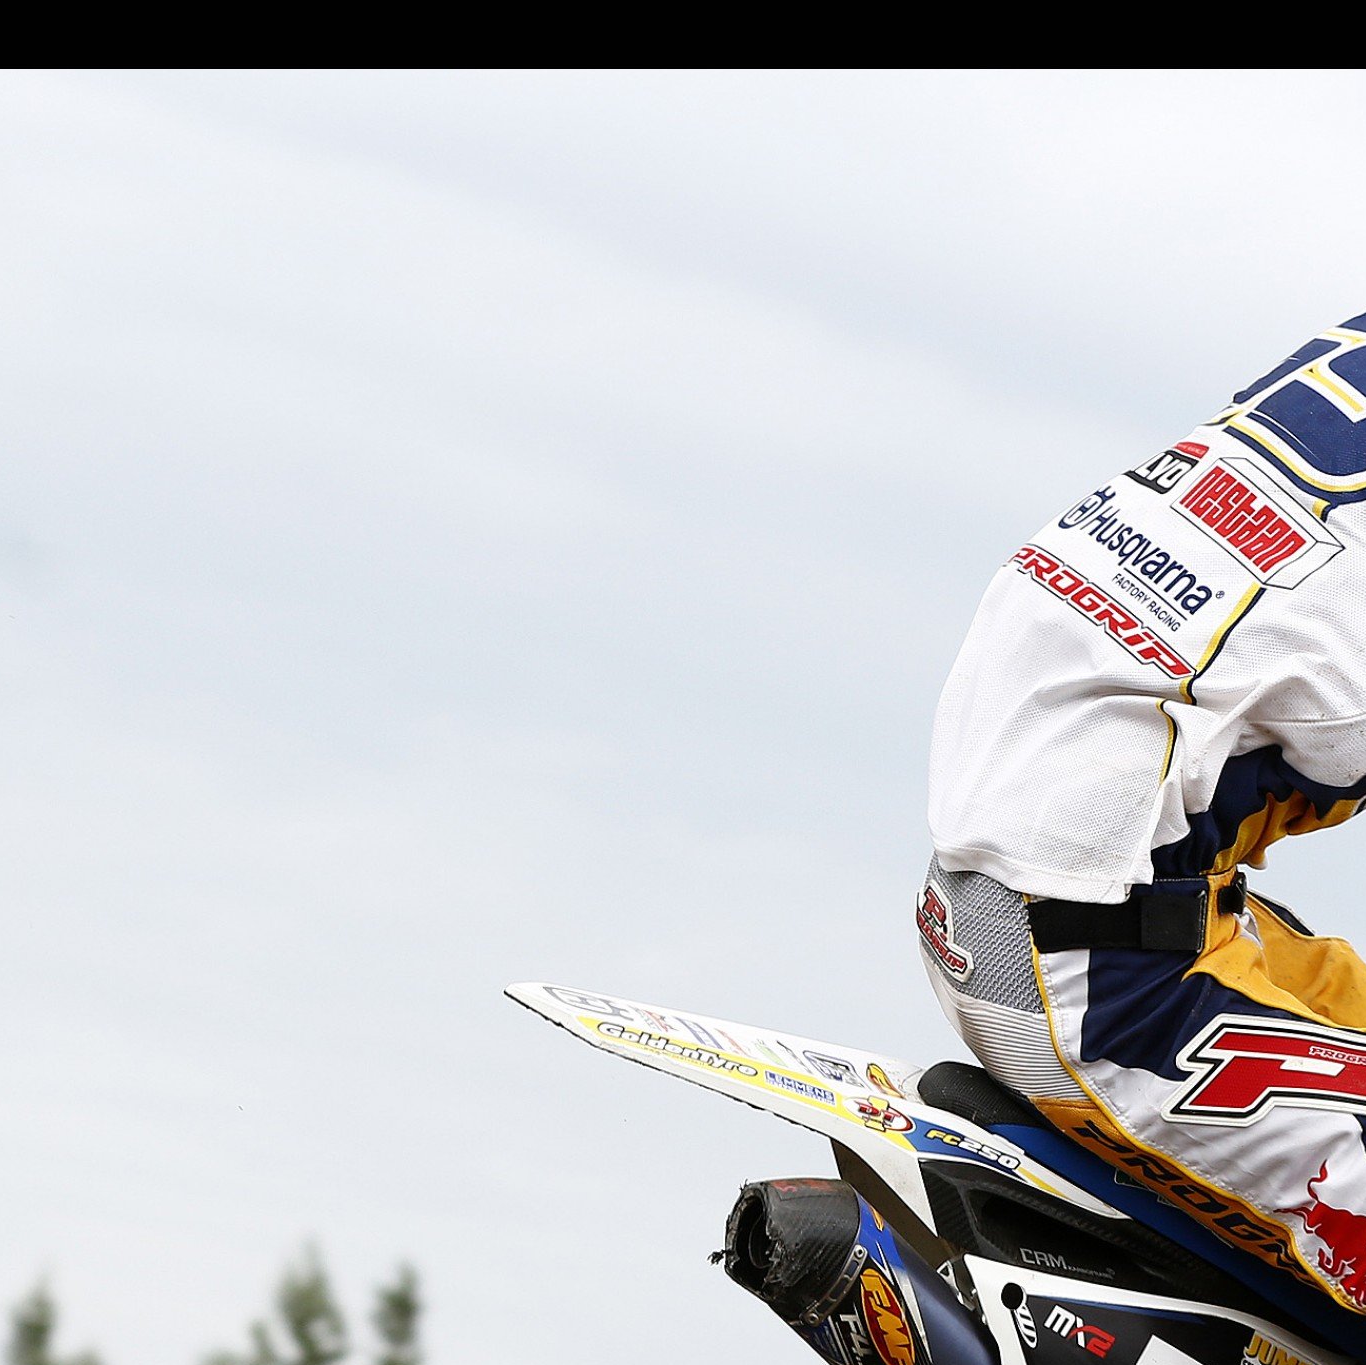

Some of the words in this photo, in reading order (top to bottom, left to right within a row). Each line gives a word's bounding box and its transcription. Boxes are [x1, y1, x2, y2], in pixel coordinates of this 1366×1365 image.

[1134, 452, 1192, 489] LVO
[1111, 573, 1151, 605] FACTORY
[1146, 600, 1182, 633] RACING
[925, 1129, 1022, 1170] FC250
[1043, 1304, 1117, 1358] MX2
